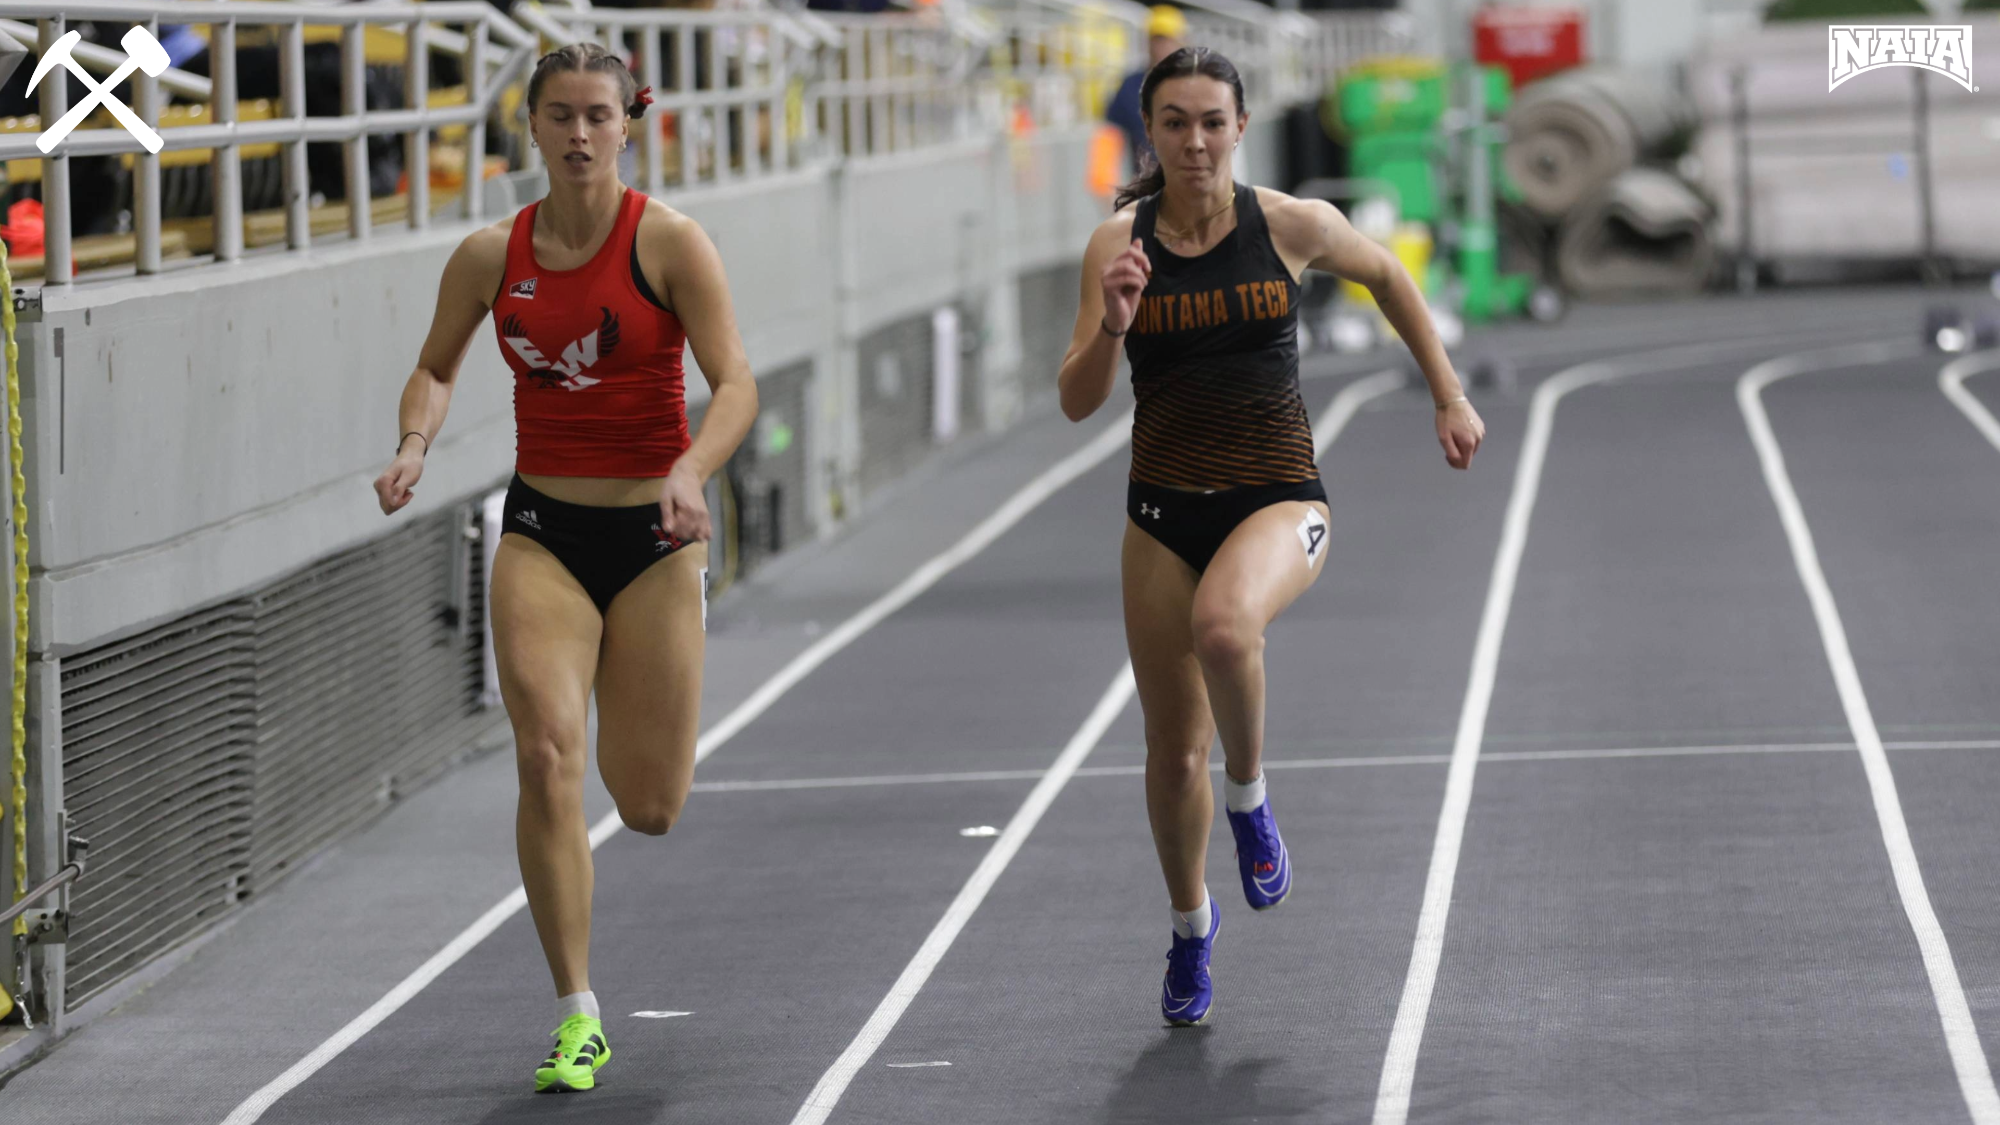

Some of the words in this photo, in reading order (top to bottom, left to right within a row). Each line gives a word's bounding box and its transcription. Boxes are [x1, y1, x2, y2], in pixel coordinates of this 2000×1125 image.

[520, 280, 536, 292] SKY
[1132, 289, 1228, 334] ONTANA
[1236, 280, 1289, 321] TECH
[515, 512, 542, 530] adidas
